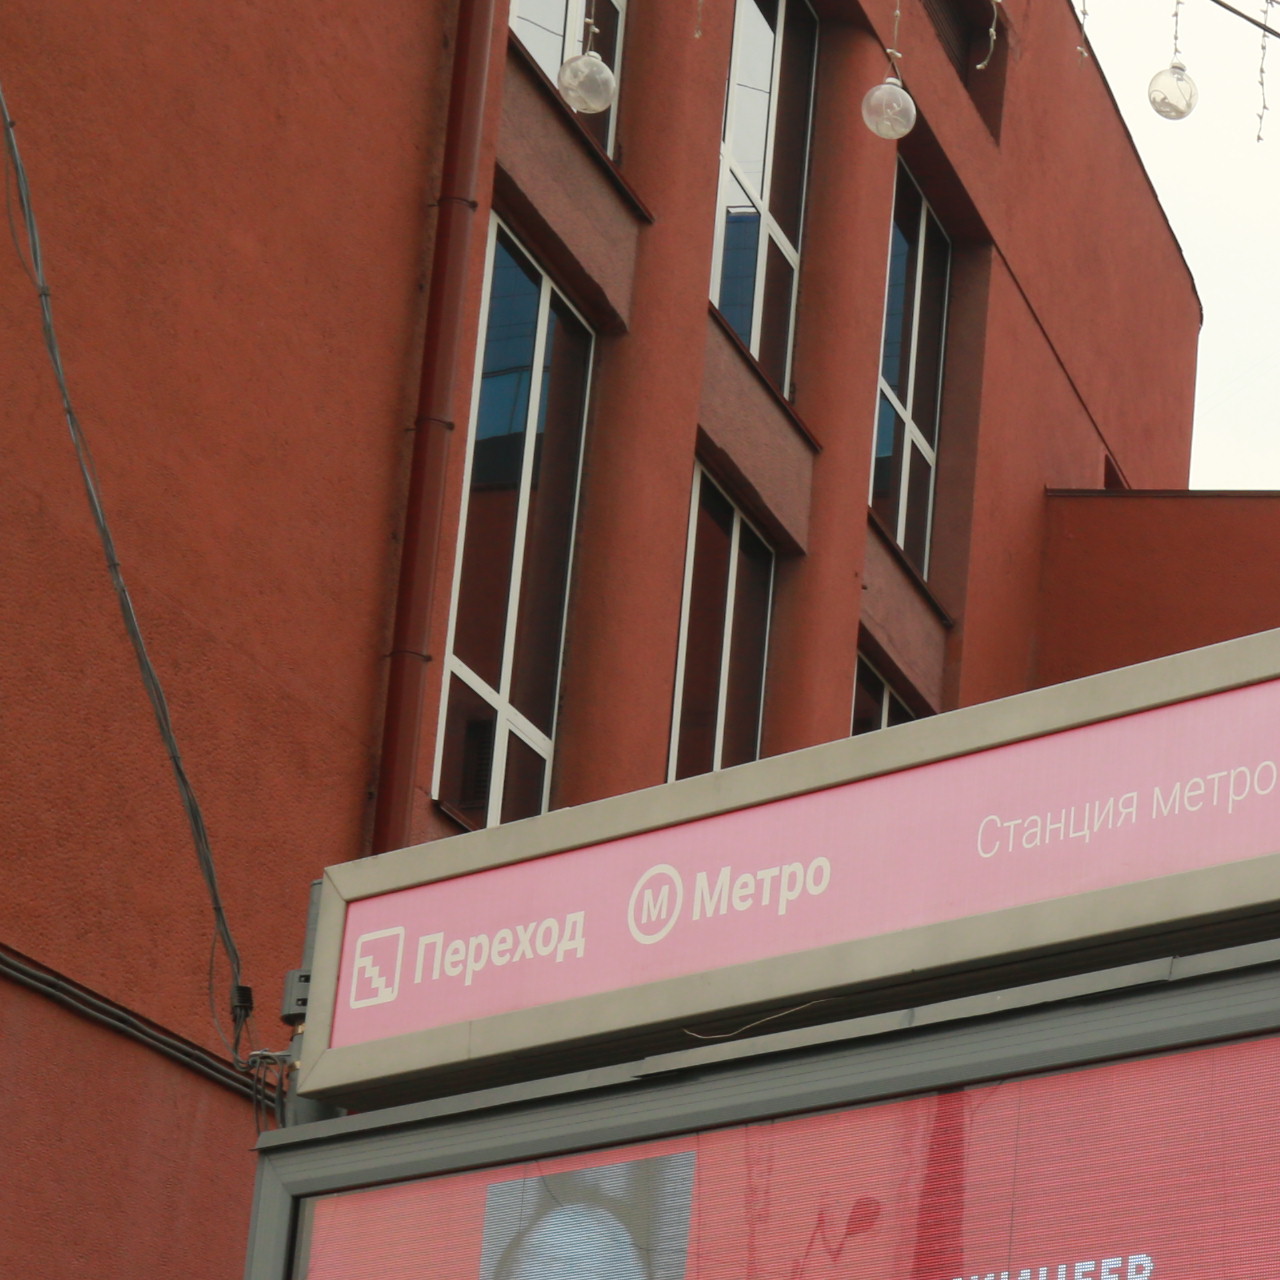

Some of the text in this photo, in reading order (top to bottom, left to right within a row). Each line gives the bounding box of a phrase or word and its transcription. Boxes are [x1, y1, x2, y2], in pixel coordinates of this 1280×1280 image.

[977, 791, 1139, 859] Станция
[1151, 761, 1278, 820] метро
[692, 856, 832, 921] Метро
[414, 909, 587, 985] Переход
